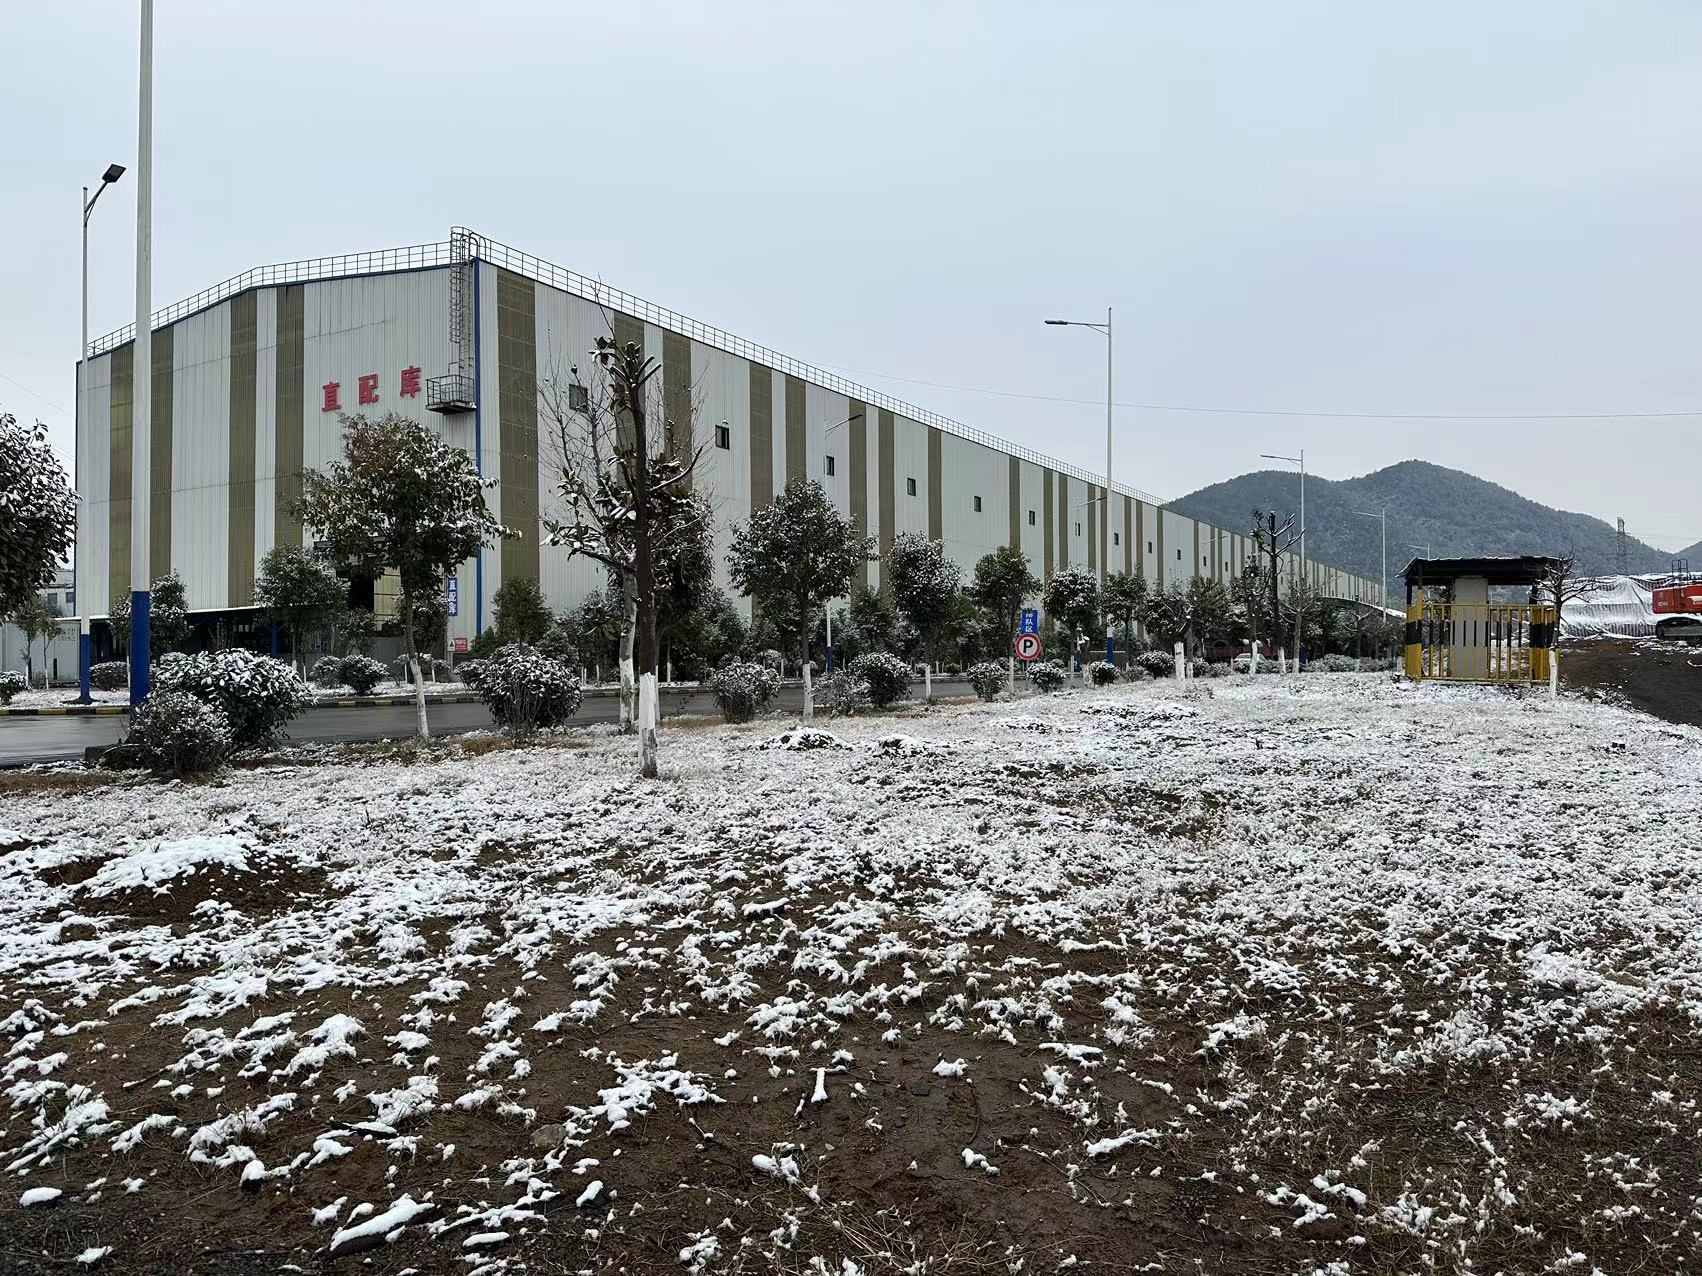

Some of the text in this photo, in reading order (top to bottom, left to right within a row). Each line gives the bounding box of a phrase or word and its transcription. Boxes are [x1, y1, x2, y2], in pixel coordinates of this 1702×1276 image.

[321, 365, 421, 413] 直配库
[1023, 639, 1034, 654] P
